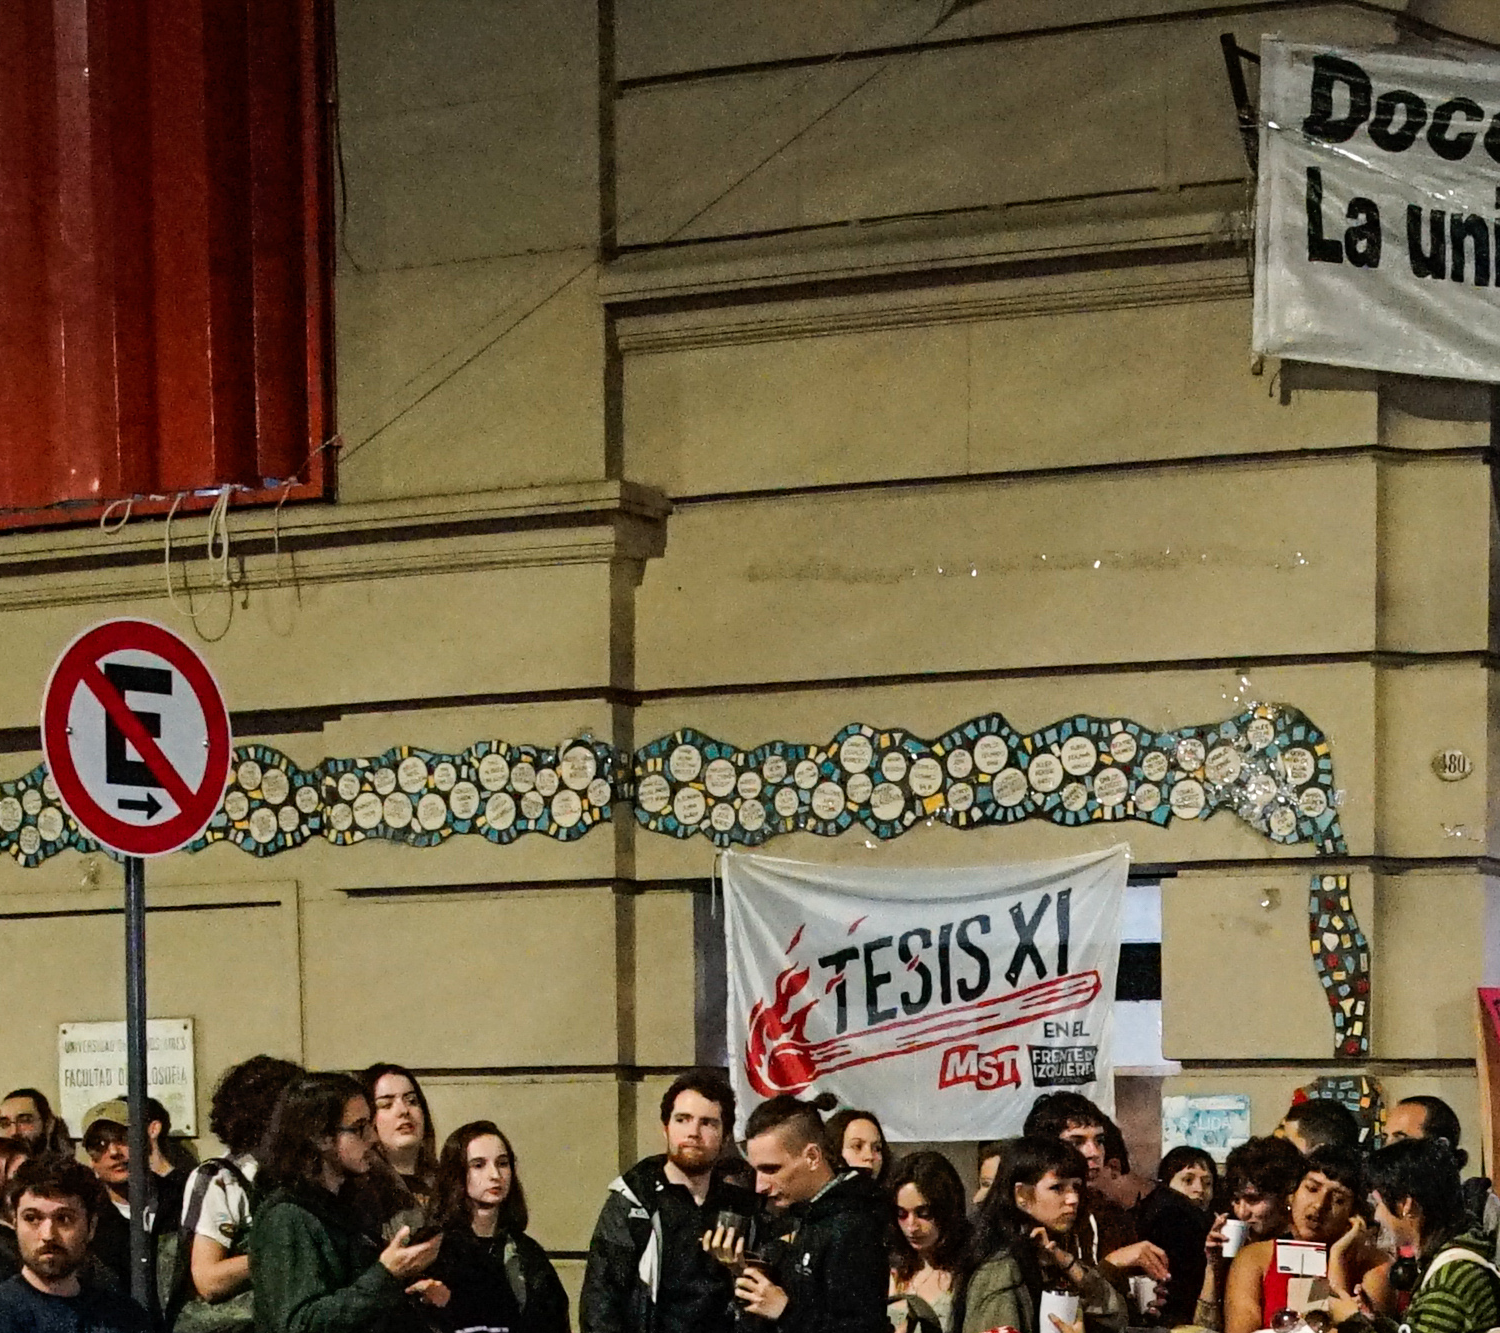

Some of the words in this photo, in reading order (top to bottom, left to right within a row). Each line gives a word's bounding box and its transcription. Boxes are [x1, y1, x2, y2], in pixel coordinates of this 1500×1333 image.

[1305, 167, 1384, 267] La
[818, 913, 992, 1033] TESIS
[1005, 887, 1072, 987] XI
[1044, 1021, 1069, 1038] EN
[1072, 1020, 1090, 1037] EL
[946, 1048, 1020, 1087] MST
[1032, 1048, 1084, 1063] FRENTE
[64, 1068, 113, 1087] FACULTAD
[118, 1068, 128, 1086] D
